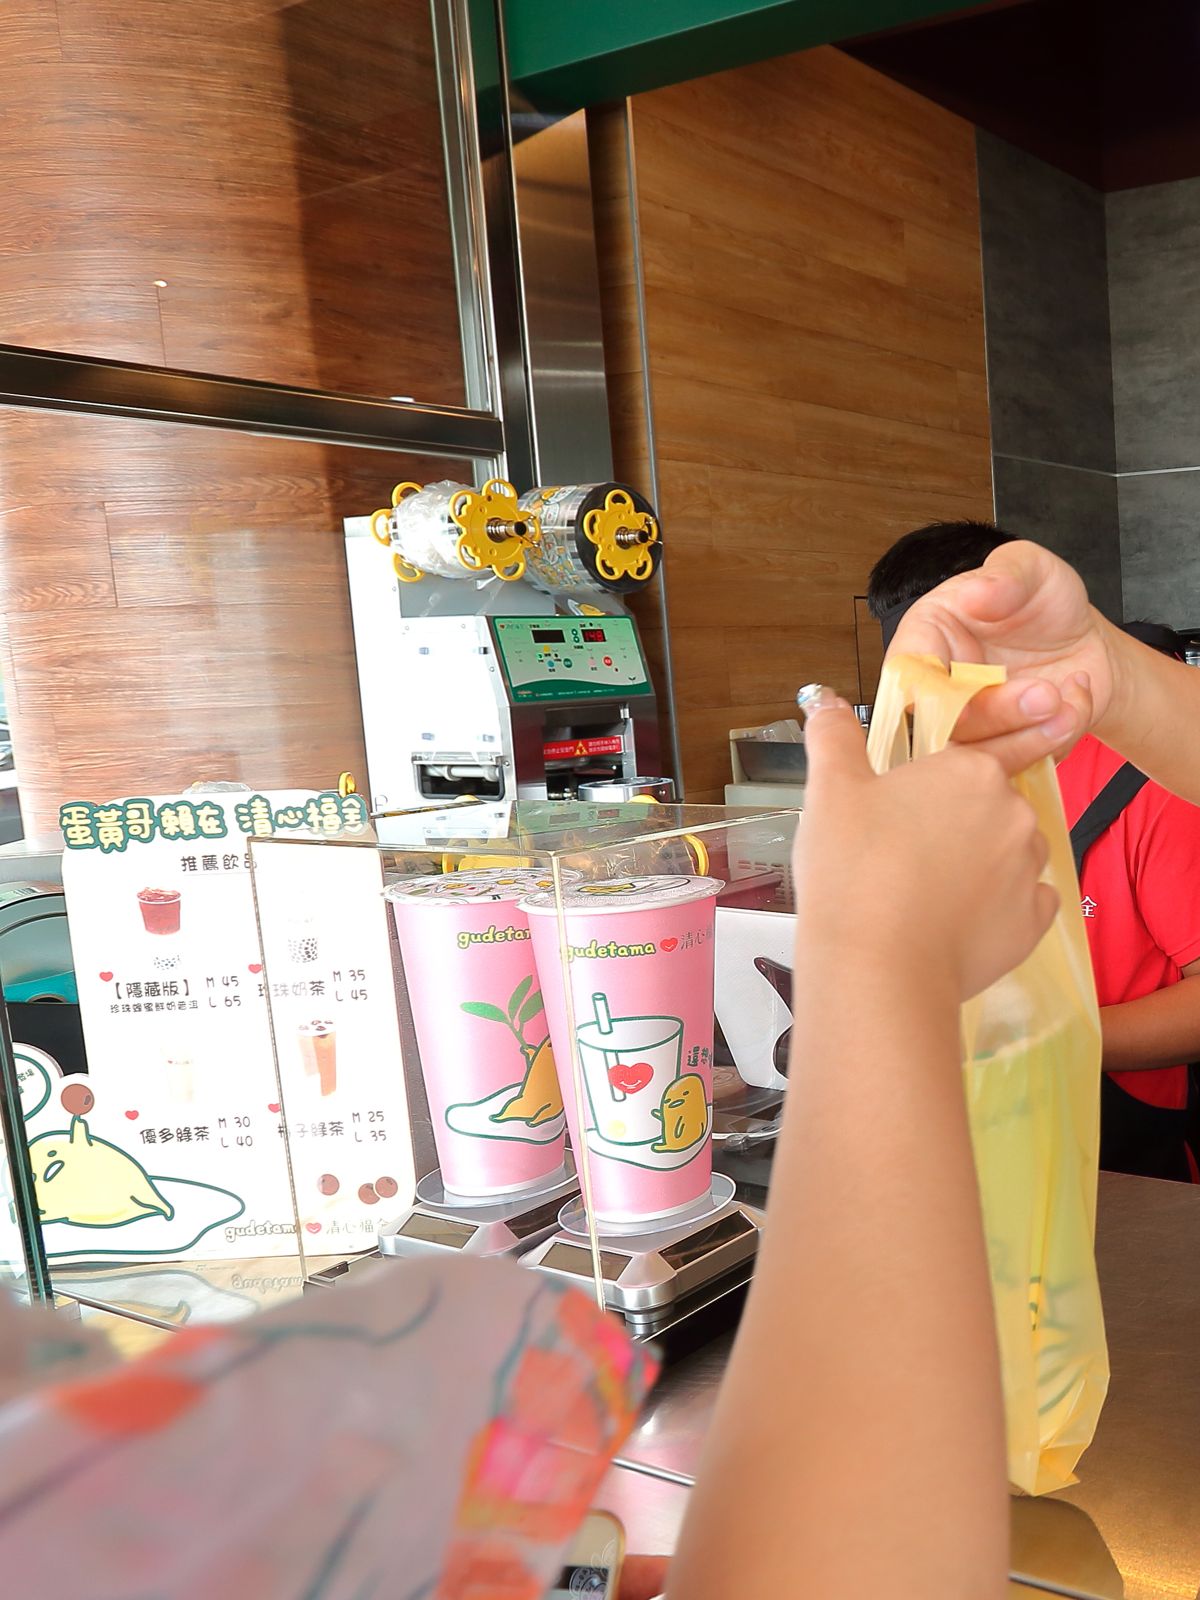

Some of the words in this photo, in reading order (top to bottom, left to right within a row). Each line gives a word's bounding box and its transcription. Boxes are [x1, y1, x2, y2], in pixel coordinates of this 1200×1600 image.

[236, 795, 367, 837] 清心福全
[1081, 895, 1097, 918] 全
[333, 971, 341, 981] M
[349, 969, 365, 981] 35
[206, 976, 214, 987] M
[222, 976, 239, 987] 45
[209, 997, 217, 1007] L
[225, 995, 241, 1007] 65
[335, 990, 343, 1001] L
[351, 989, 368, 1000] 45
[218, 1118, 227, 1128] M
[235, 1116, 250, 1128] 30
[352, 1112, 361, 1123] M
[368, 1111, 384, 1122] 25
[140, 1126, 210, 1144] 優多綠茶
[355, 1131, 363, 1142] L
[371, 1130, 387, 1141] 35
[221, 1137, 229, 1148] L
[237, 1136, 253, 1147] 40
